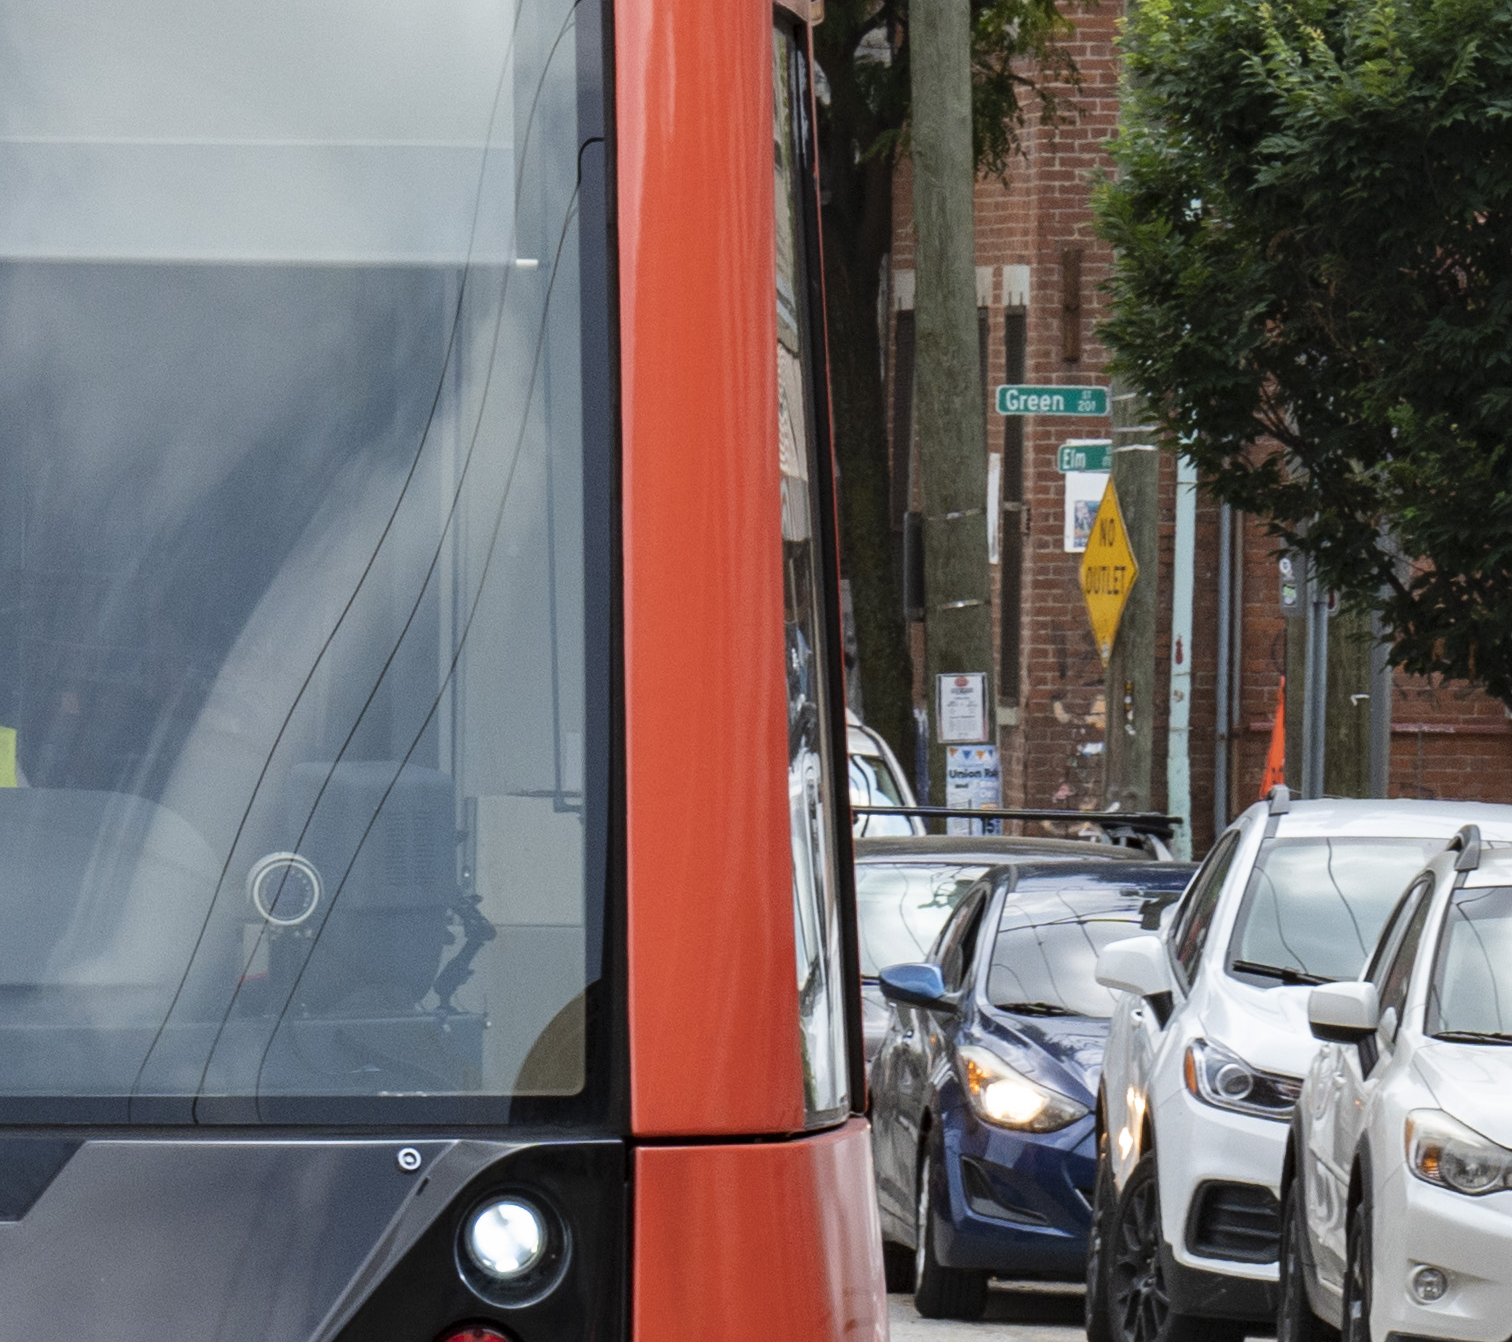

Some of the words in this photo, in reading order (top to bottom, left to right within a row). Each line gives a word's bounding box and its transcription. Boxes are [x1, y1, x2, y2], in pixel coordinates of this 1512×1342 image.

[1006, 390, 1064, 411] Green
[1078, 401, 1096, 411] 201
[1062, 449, 1086, 469] Elm
[1100, 518, 1115, 546] NO
[1086, 566, 1126, 595] OUTLET
[949, 768, 982, 779] Union
